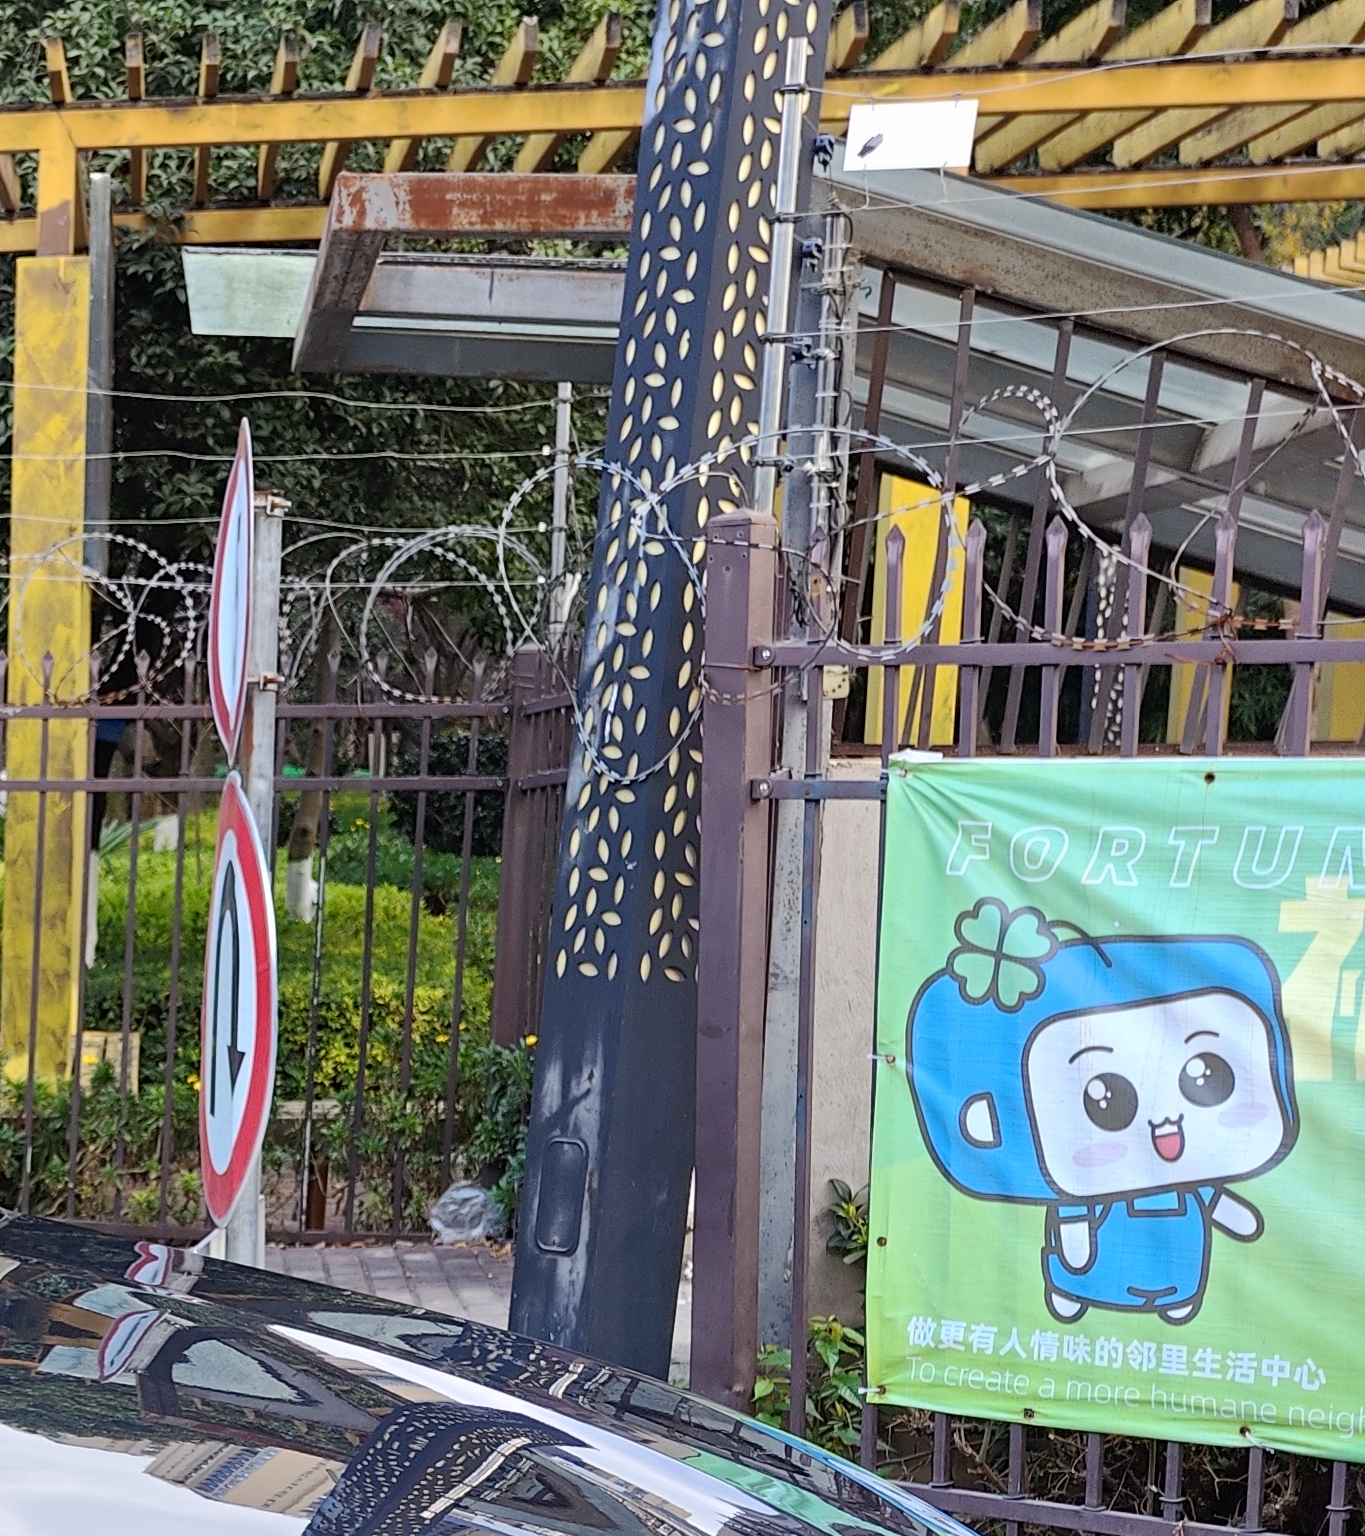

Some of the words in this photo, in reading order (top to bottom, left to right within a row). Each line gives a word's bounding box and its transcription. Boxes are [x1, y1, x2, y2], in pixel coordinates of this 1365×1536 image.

[907, 1316, 1327, 1391] 做更有人情味的邻里生活中心
[906, 1356, 936, 1383] To
[943, 1363, 1030, 1395] create
[1038, 1377, 1056, 1399] a
[1066, 1379, 1141, 1407] more
[1151, 1383, 1277, 1424] humane
